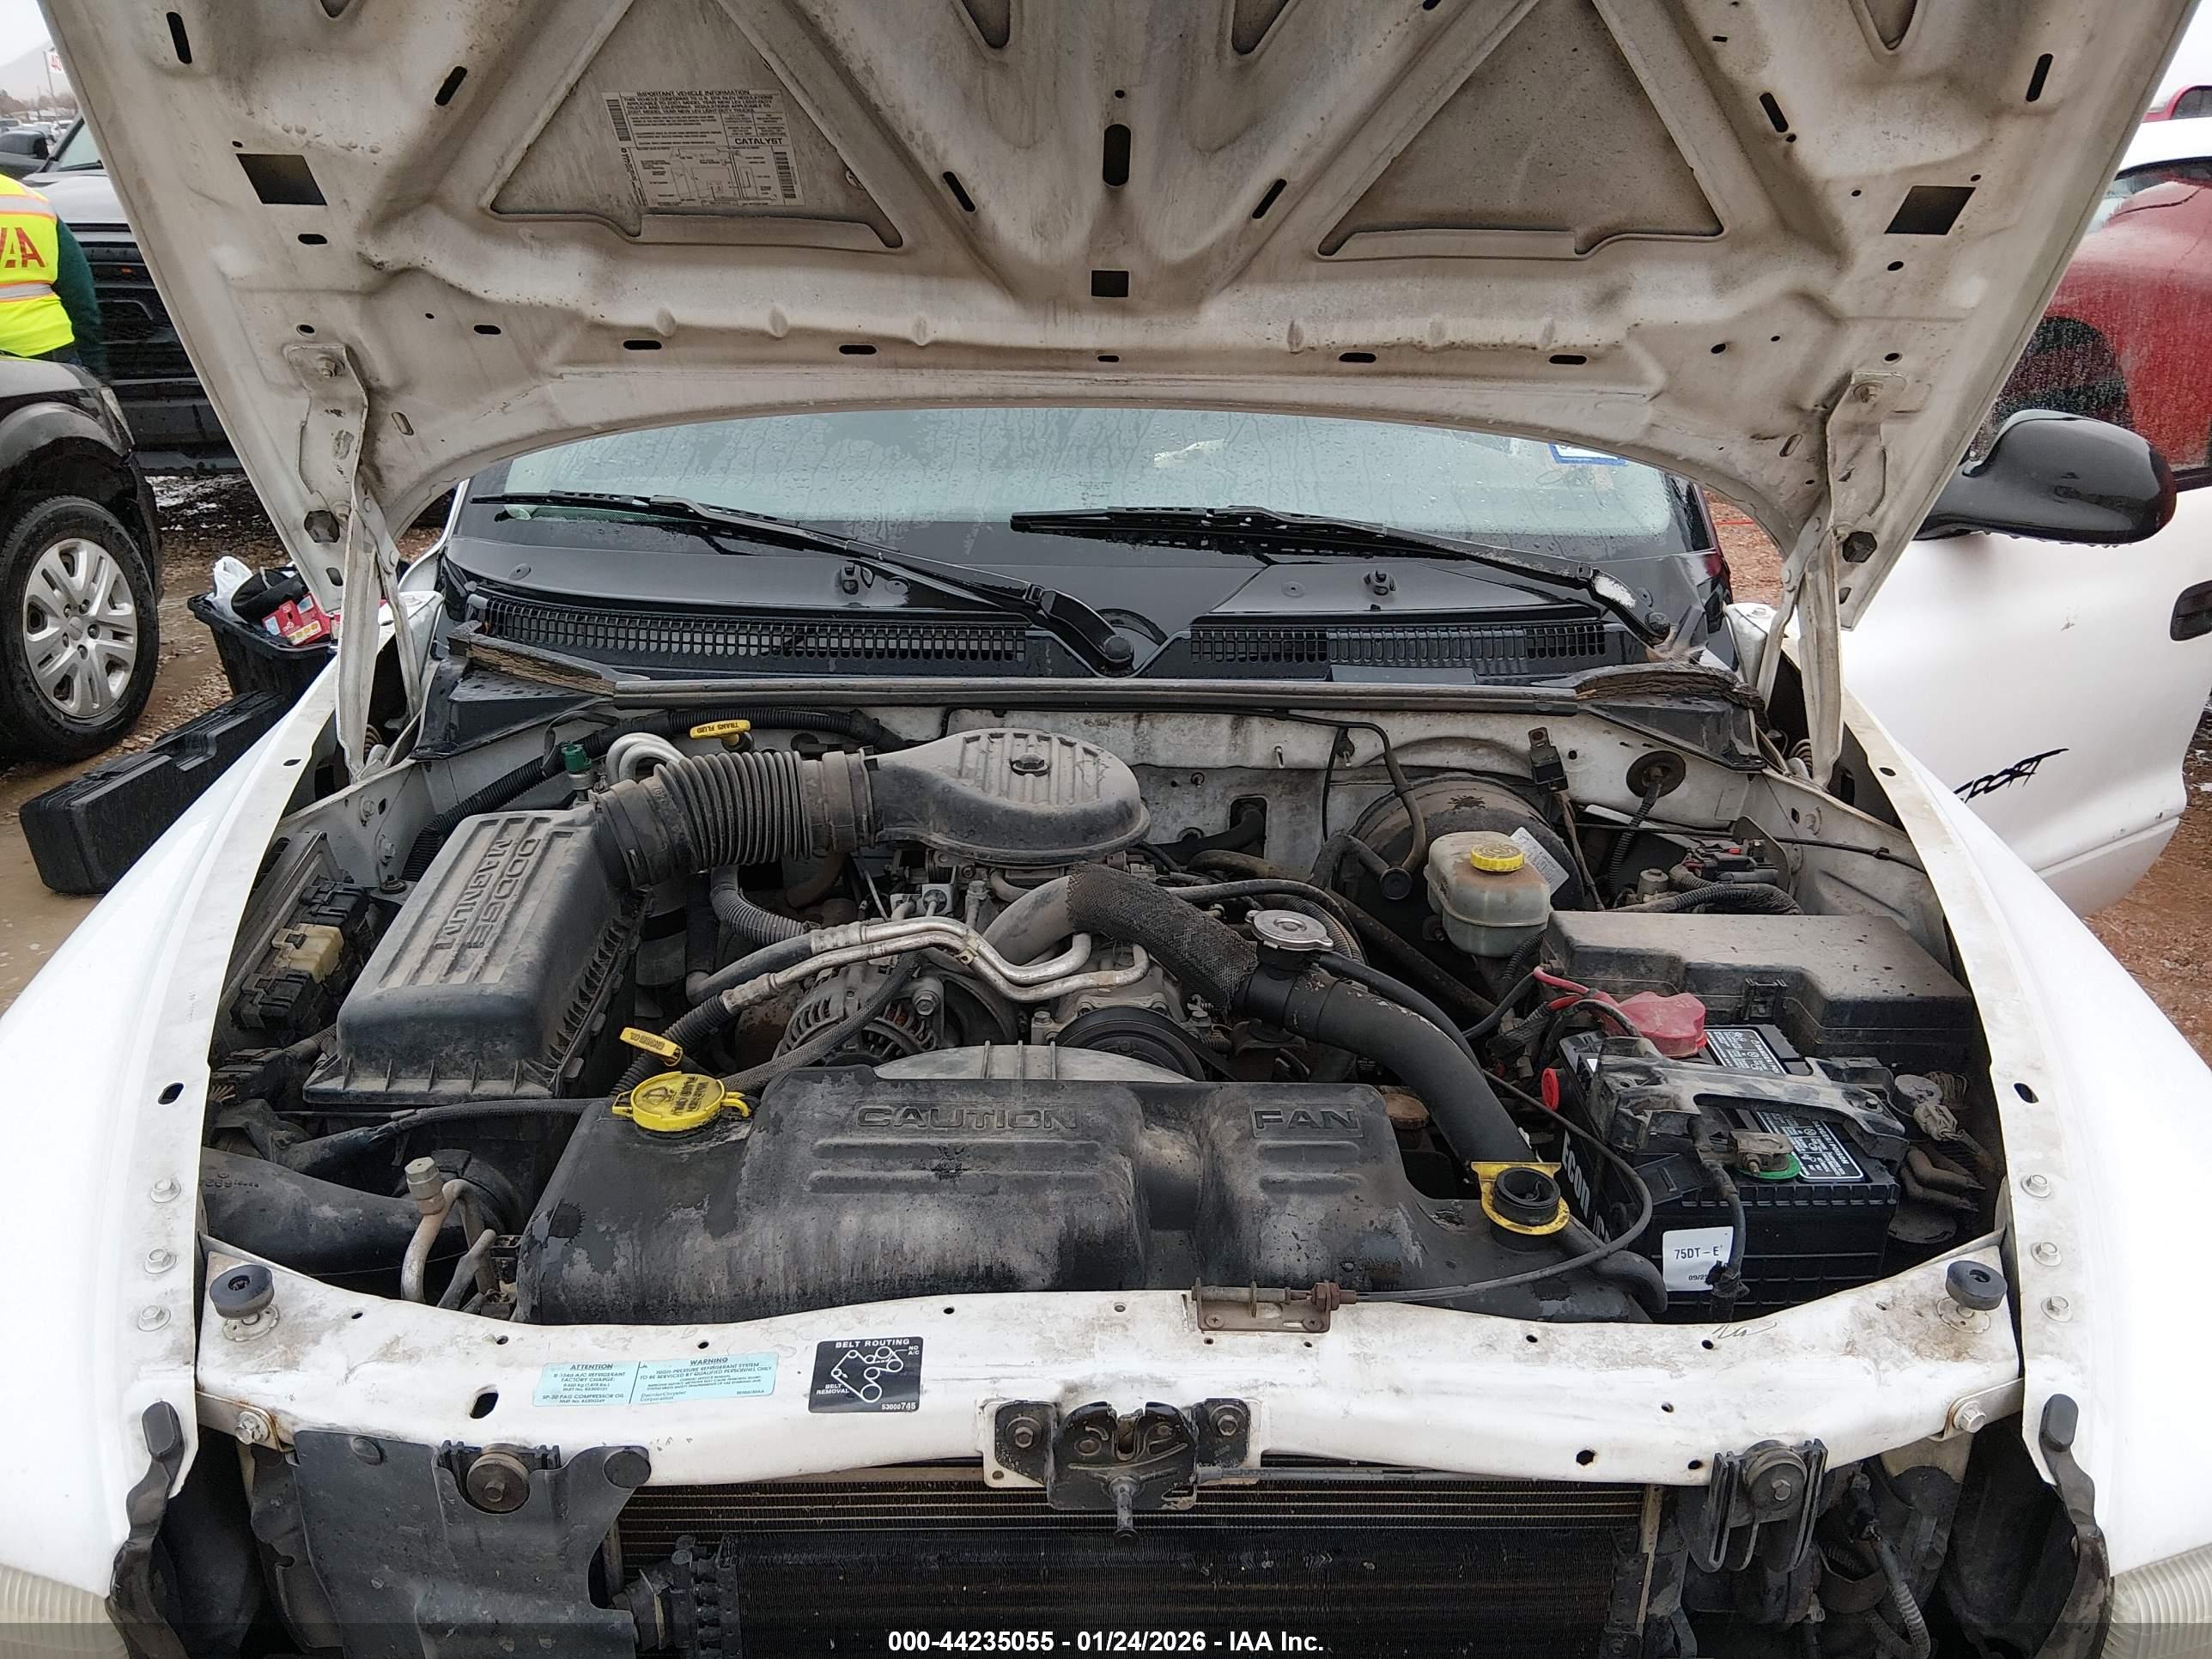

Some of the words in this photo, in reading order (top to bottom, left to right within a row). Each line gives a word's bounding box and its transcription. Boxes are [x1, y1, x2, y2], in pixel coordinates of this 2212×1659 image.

[434, 839, 514, 950] MAGNUM
[466, 838, 542, 949] DODGE
[857, 1107, 1078, 1129] CAUTION
[1254, 1109, 1359, 1129] FAN
[864, 1339, 910, 1347] ROUTING
[690, 1357, 729, 1365] WARNING
